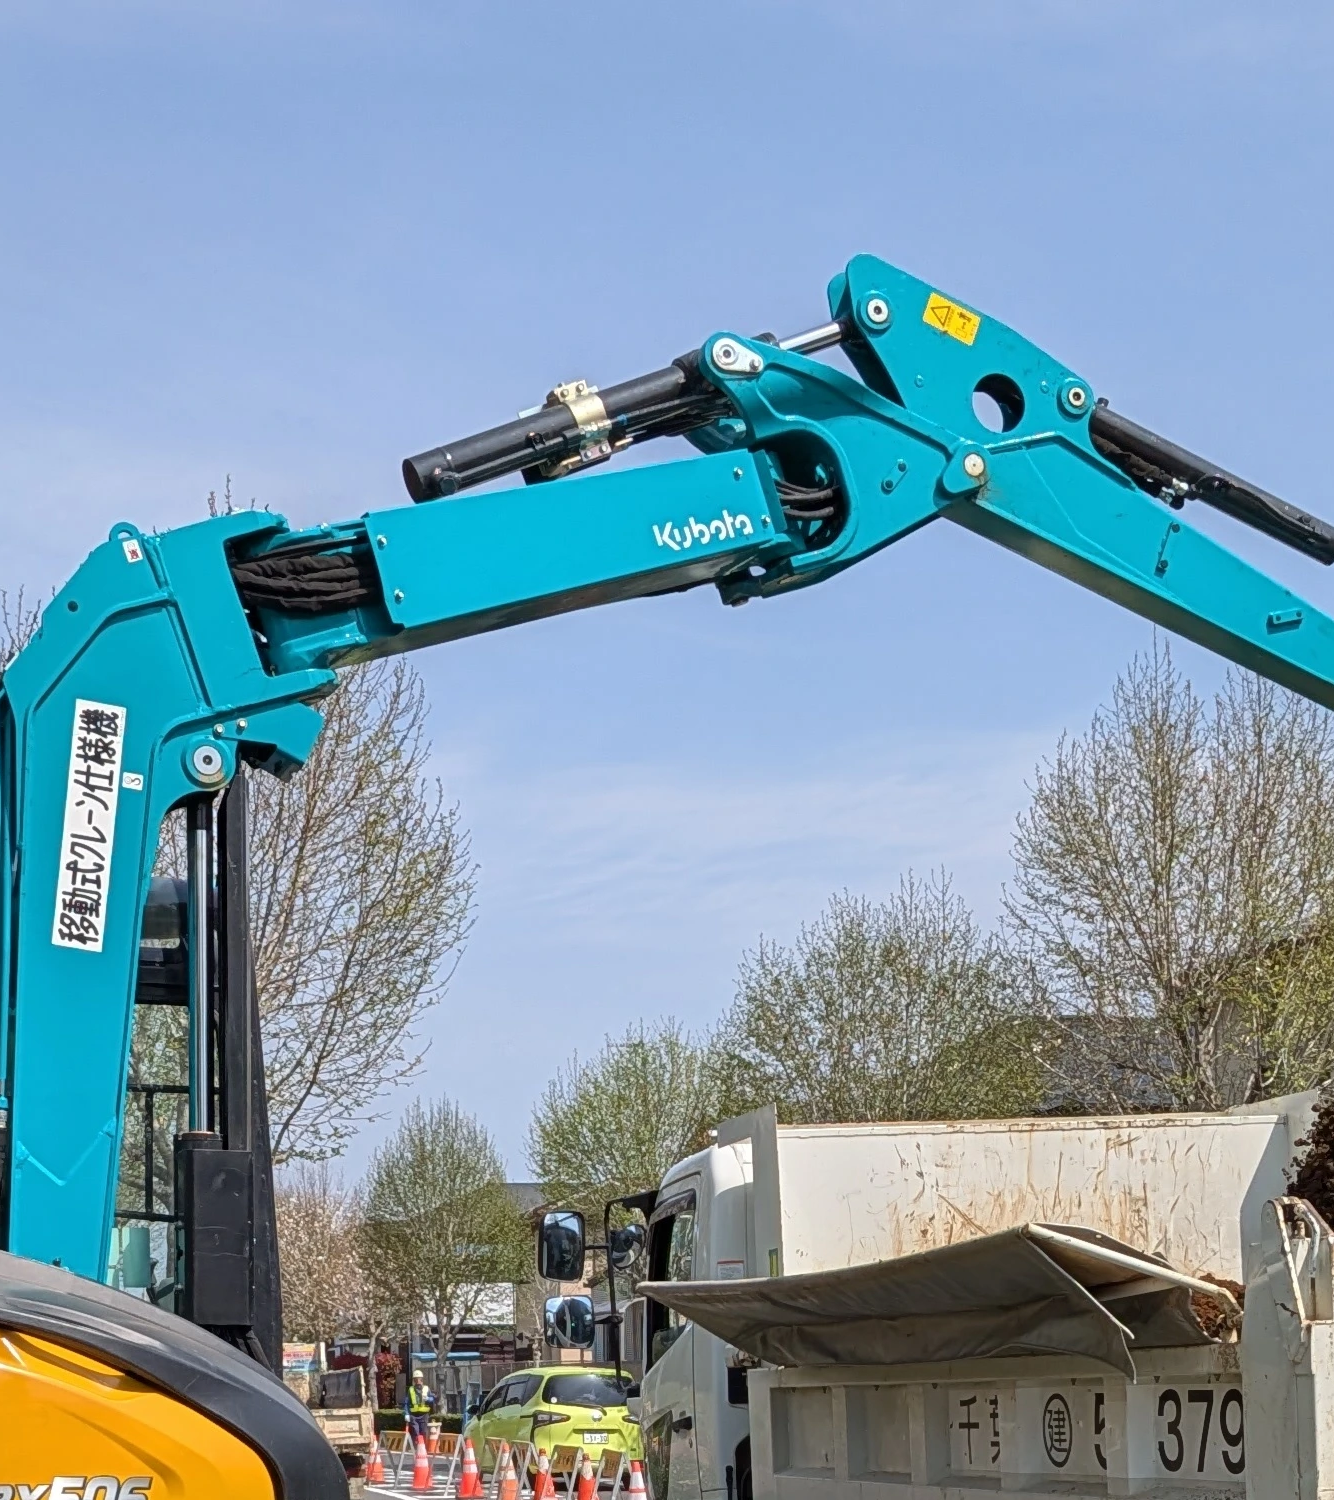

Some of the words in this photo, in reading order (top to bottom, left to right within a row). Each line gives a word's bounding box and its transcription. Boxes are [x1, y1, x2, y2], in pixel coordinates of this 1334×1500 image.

[652, 509, 754, 551] Kubota
[58, 708, 120, 945] 移動式クレーン仕様機
